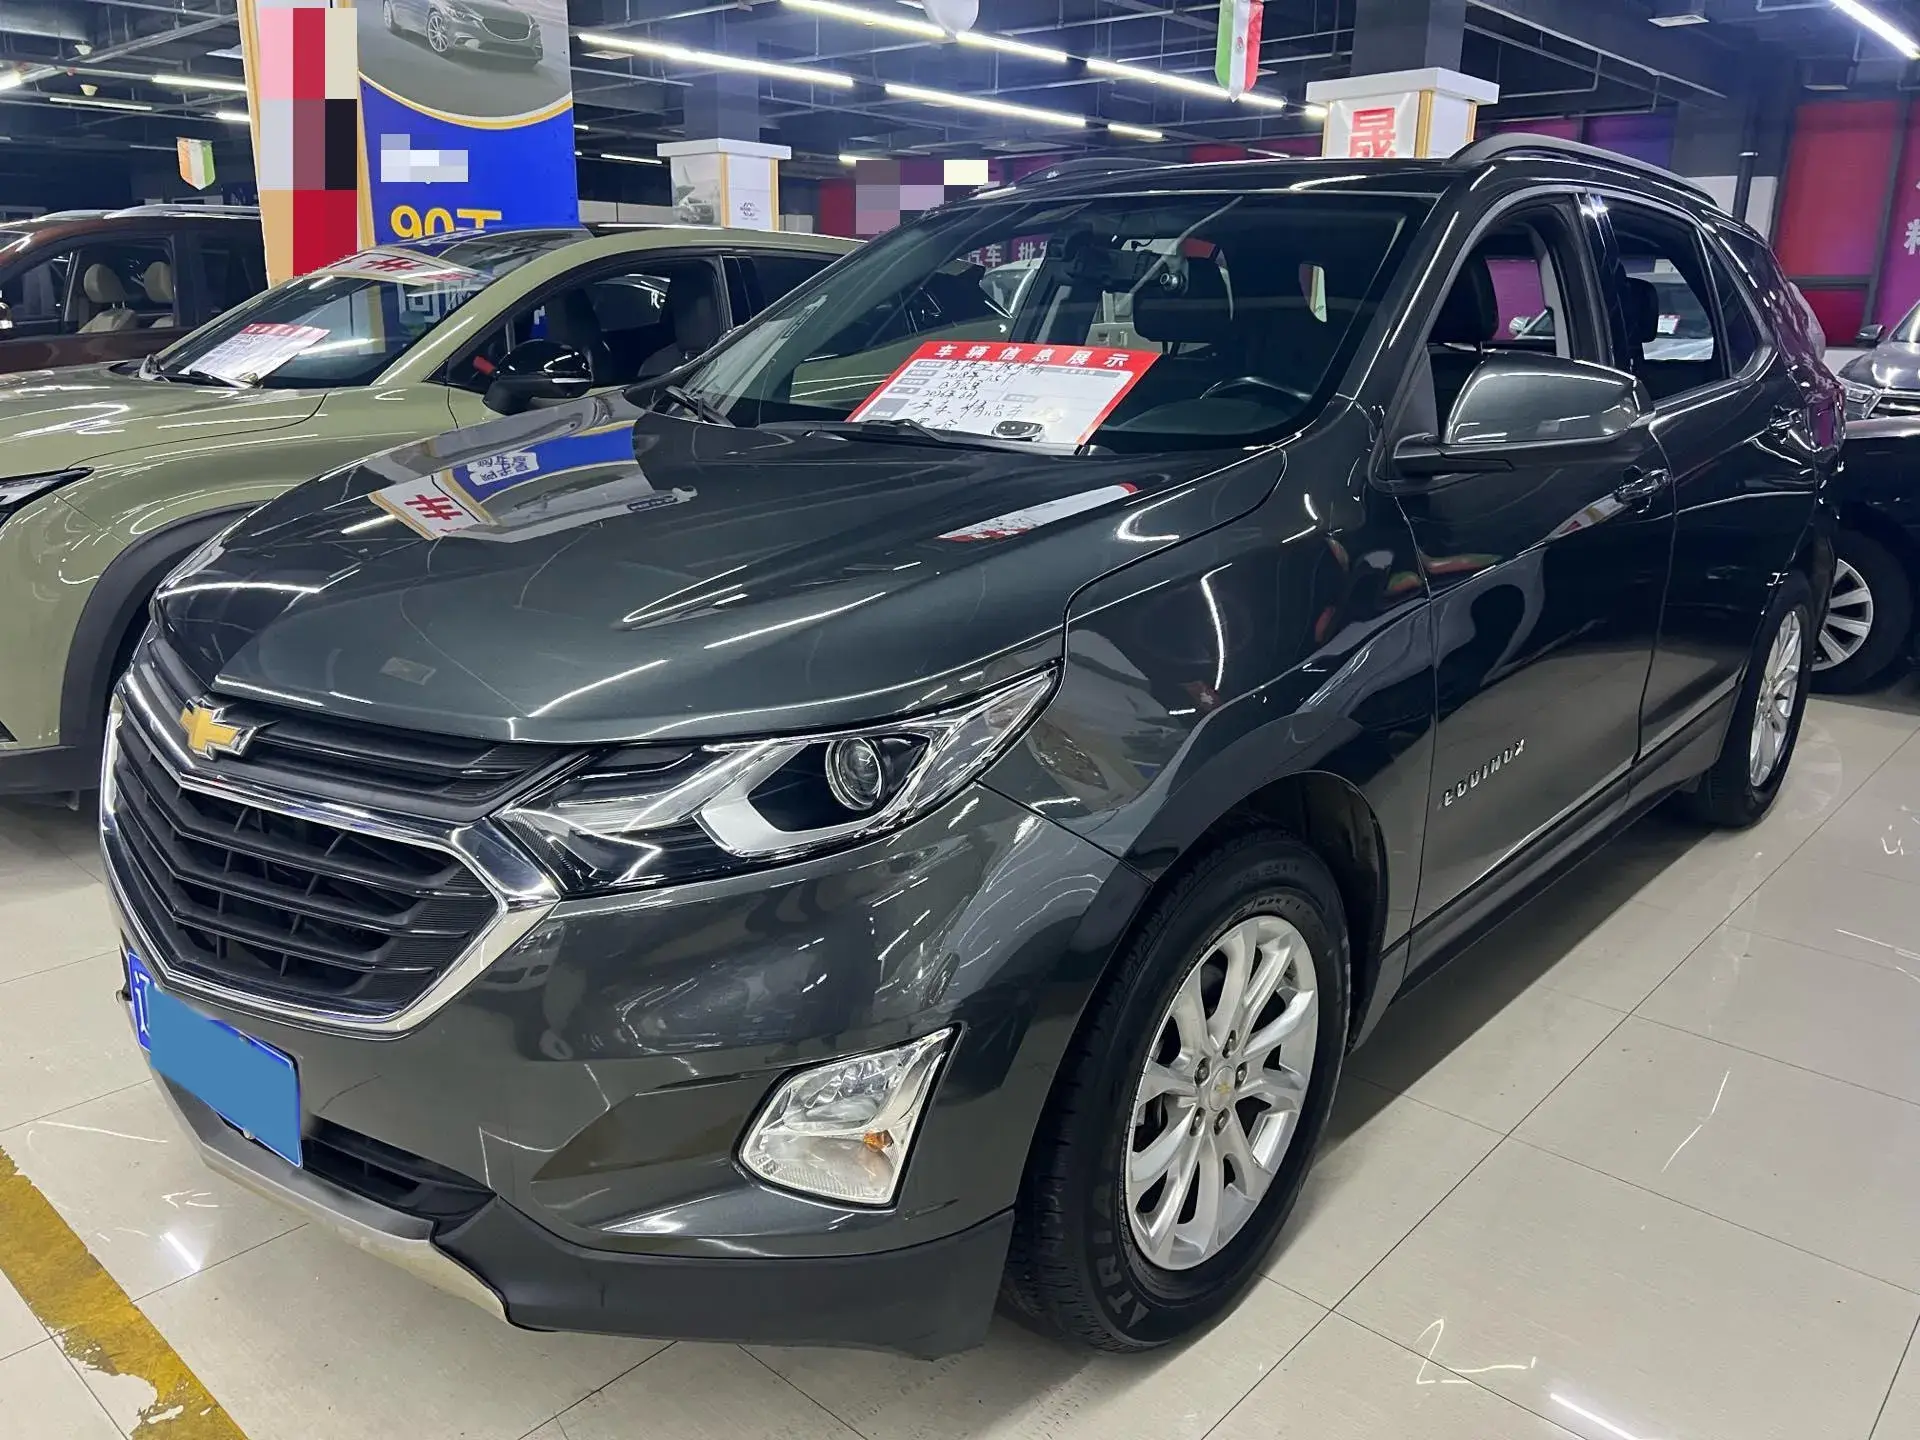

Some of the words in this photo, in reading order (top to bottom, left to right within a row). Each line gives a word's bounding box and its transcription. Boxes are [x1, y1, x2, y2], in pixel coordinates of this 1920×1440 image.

[935, 343, 1130, 367] 车辆信息展示
